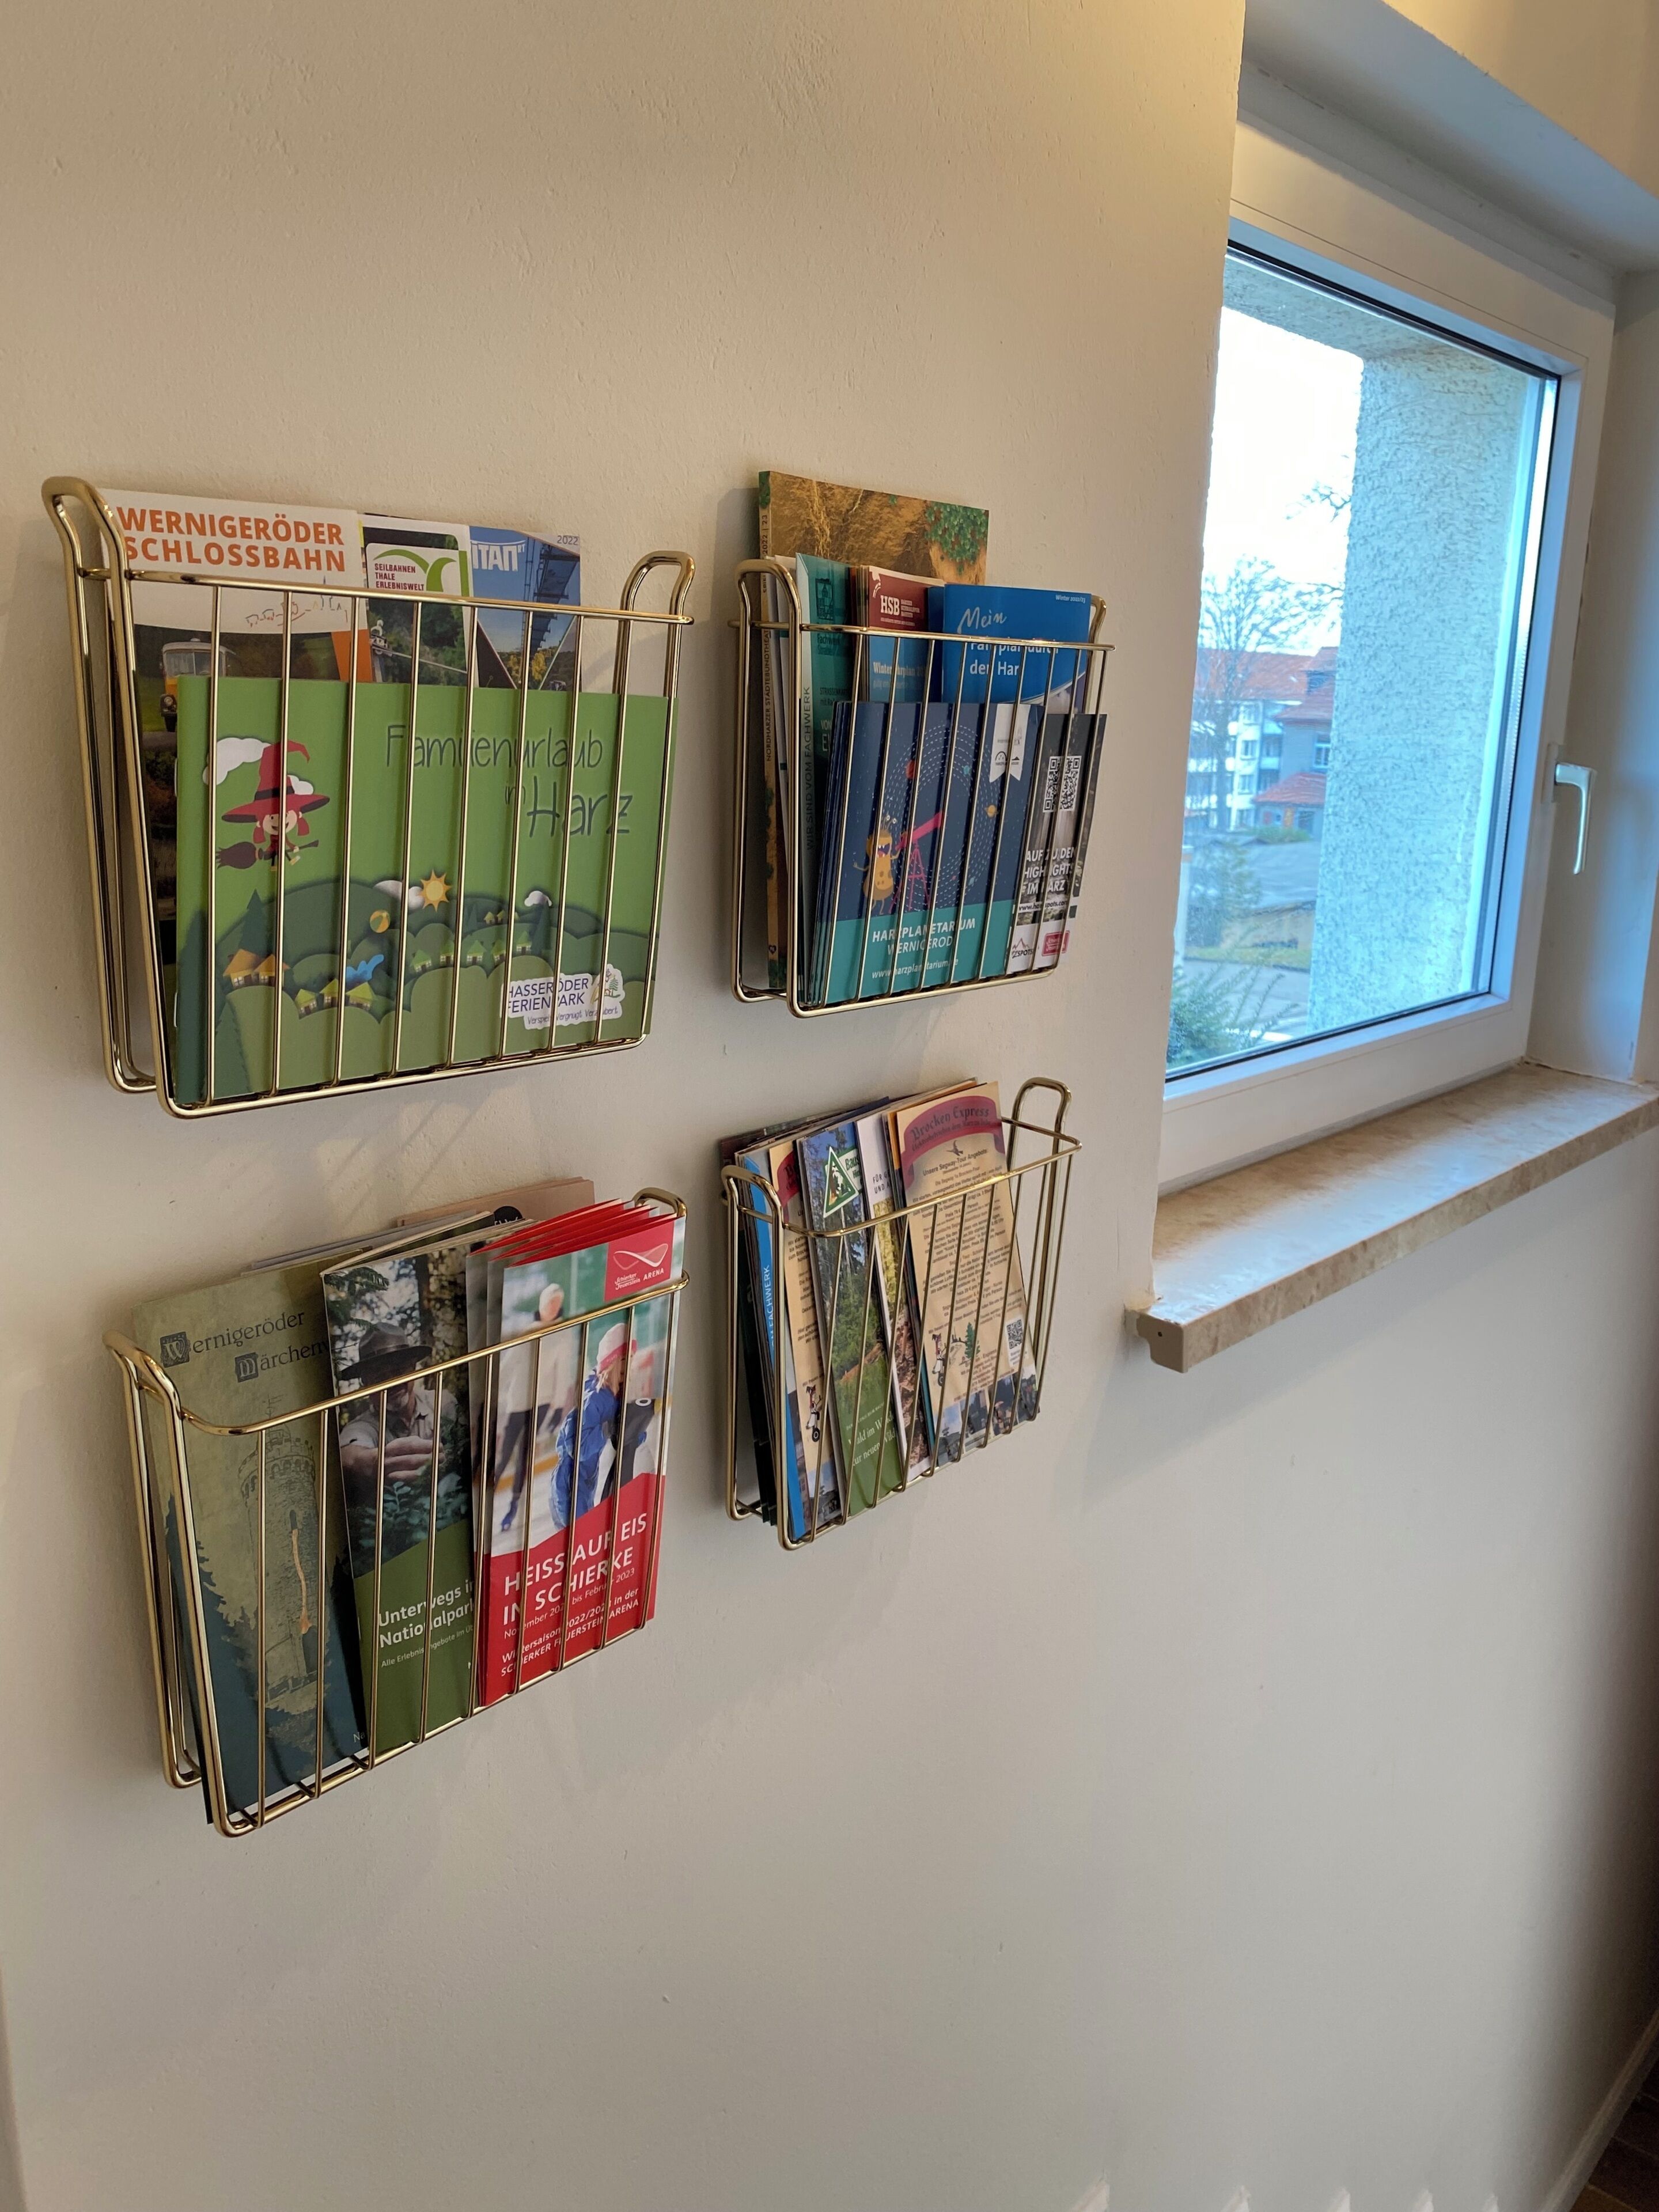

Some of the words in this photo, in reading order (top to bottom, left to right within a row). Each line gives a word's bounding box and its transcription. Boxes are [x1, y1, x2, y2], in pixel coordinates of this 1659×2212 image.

[117, 507, 344, 546] WERNIGERÖDER
[762, 515, 767, 525] 23
[556, 535, 578, 545] 2022
[126, 536, 345, 571] SCHLOSSBAHN
[374, 563, 416, 573] SEILBAHNEN
[375, 572, 395, 581] THALE
[376, 581, 425, 591] ERLEBNISWELT
[880, 595, 900, 615] HSB
[957, 607, 1007, 634] Mein
[804, 687, 812, 757] FACHWERK
[387, 724, 603, 768] Famiienurlaub
[804, 762, 812, 790] VOM
[527, 775, 633, 838] Harz
[1025, 849, 1044, 862] AUF
[508, 992, 585, 1013] ERIENARK
[911, 1113, 950, 1141] Brocken
[953, 1105, 990, 1120] Express
[923, 1166, 938, 1176] Unsere
[643, 1267, 664, 1281] ARENA
[159, 1312, 305, 1368] Wernigeröder
[505, 1552, 565, 1596] HEISS
[573, 1531, 612, 1566] AUF
[620, 1513, 647, 1542] EIS
[535, 1546, 633, 1611] SCHIERKE
[572, 1594, 583, 1605] bis
[615, 1567, 635, 1584] 2023
[614, 1596, 622, 1606] in
[624, 1588, 639, 1600] der
[608, 1599, 639, 1620] ARENA
[381, 1655, 395, 1668] Alle
